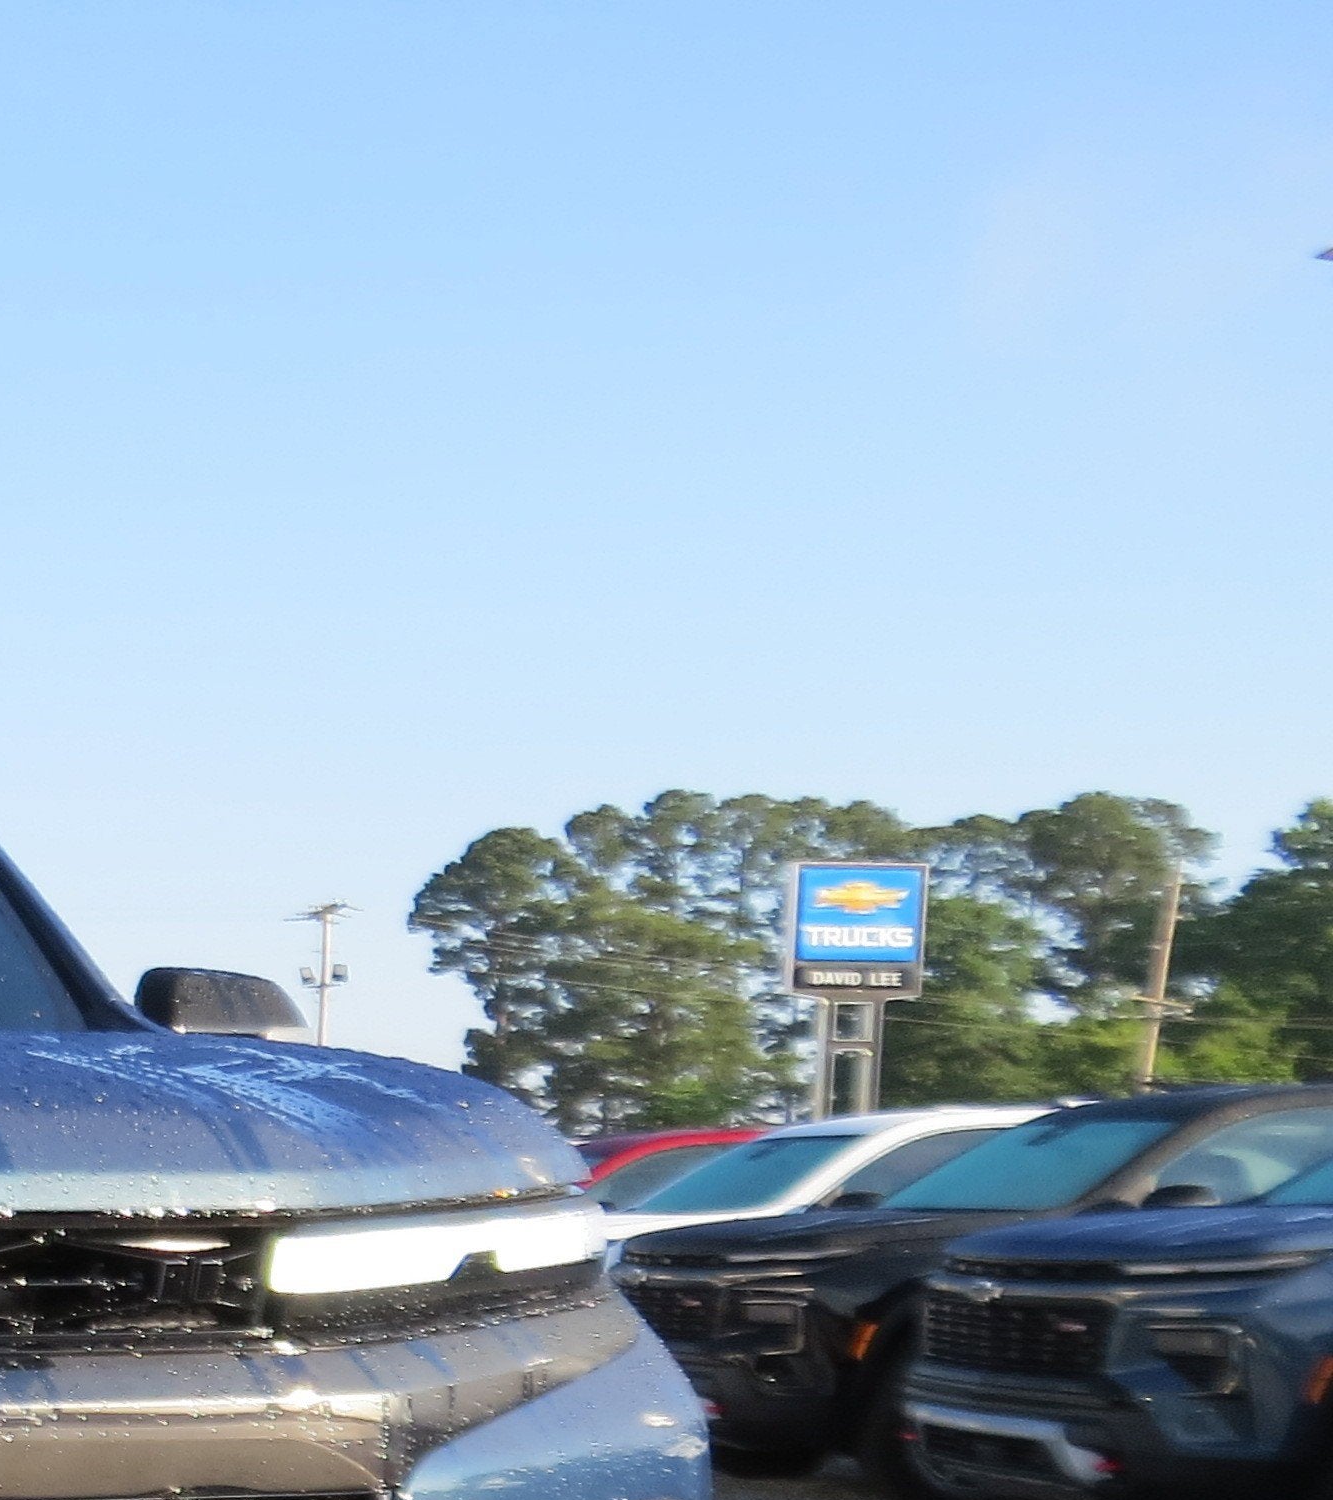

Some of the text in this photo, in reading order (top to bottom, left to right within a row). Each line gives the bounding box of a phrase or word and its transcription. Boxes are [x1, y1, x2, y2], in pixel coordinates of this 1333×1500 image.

[804, 926, 914, 947] TRUCKS
[810, 970, 903, 987] DAVID LEE
